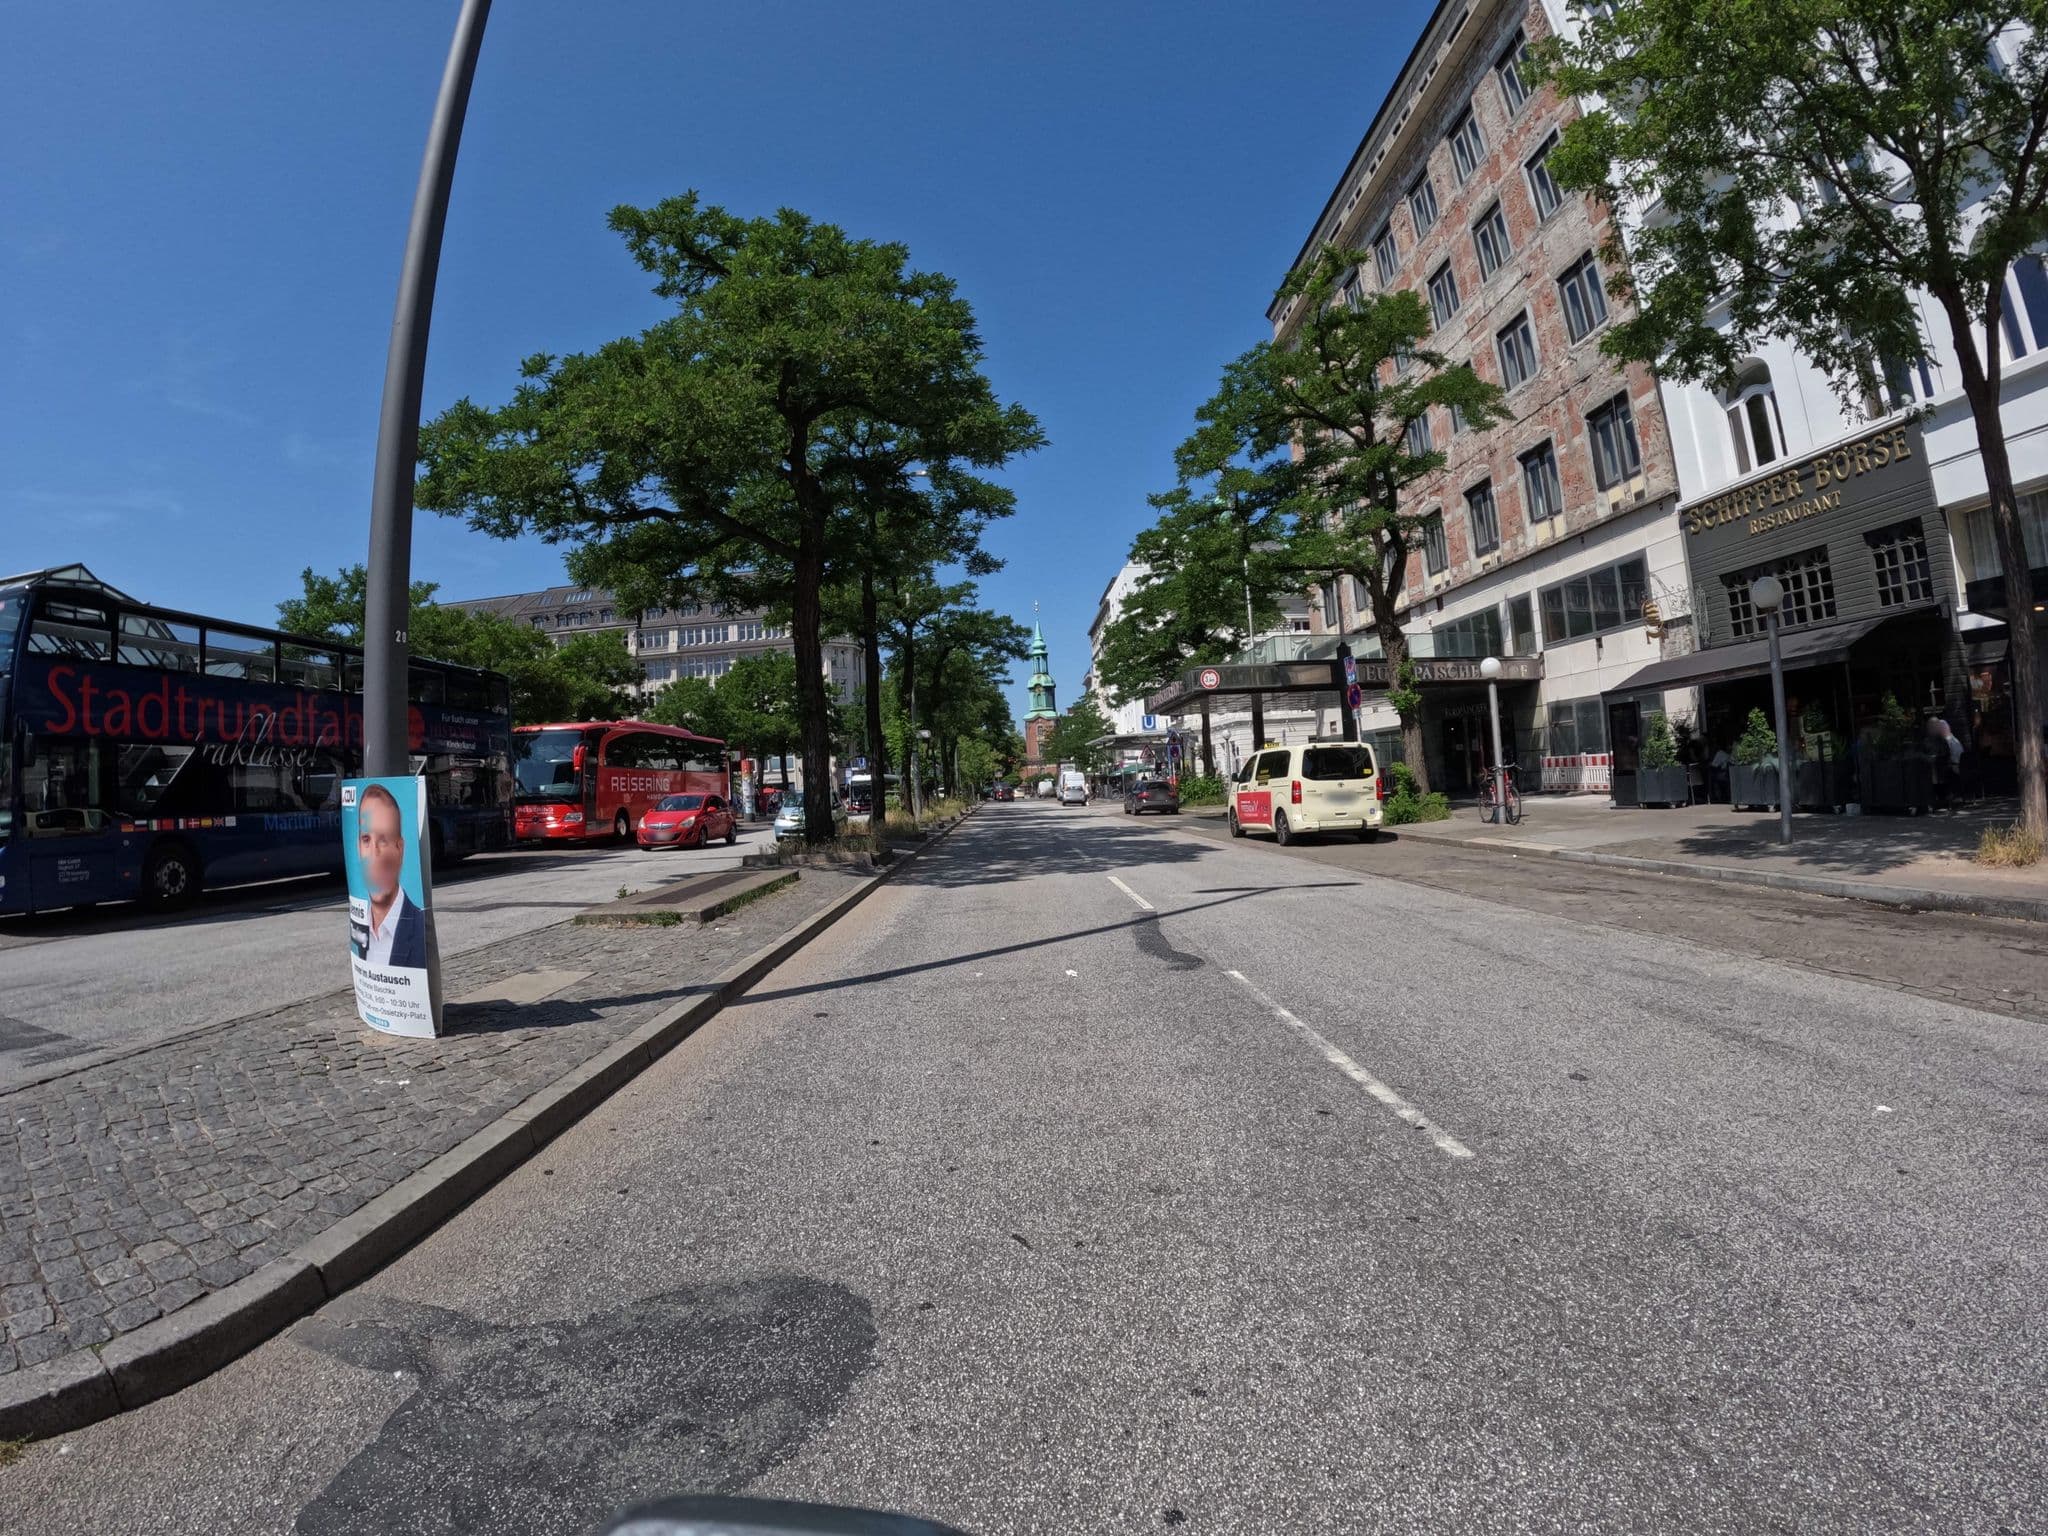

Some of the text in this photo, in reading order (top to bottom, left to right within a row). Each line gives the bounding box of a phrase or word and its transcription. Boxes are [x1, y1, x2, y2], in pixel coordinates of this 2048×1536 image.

[1688, 426, 1912, 535] SCHIFFER BÖRSE
[1750, 490, 1842, 535] RESTAURANT
[1366, 663, 1481, 680] EUPÄISCHE
[45, 666, 364, 747] Stadtrundfah
[1143, 715, 1156, 729] U
[368, 970, 411, 986] Austausch
[408, 1001, 420, 1009] Uhr
